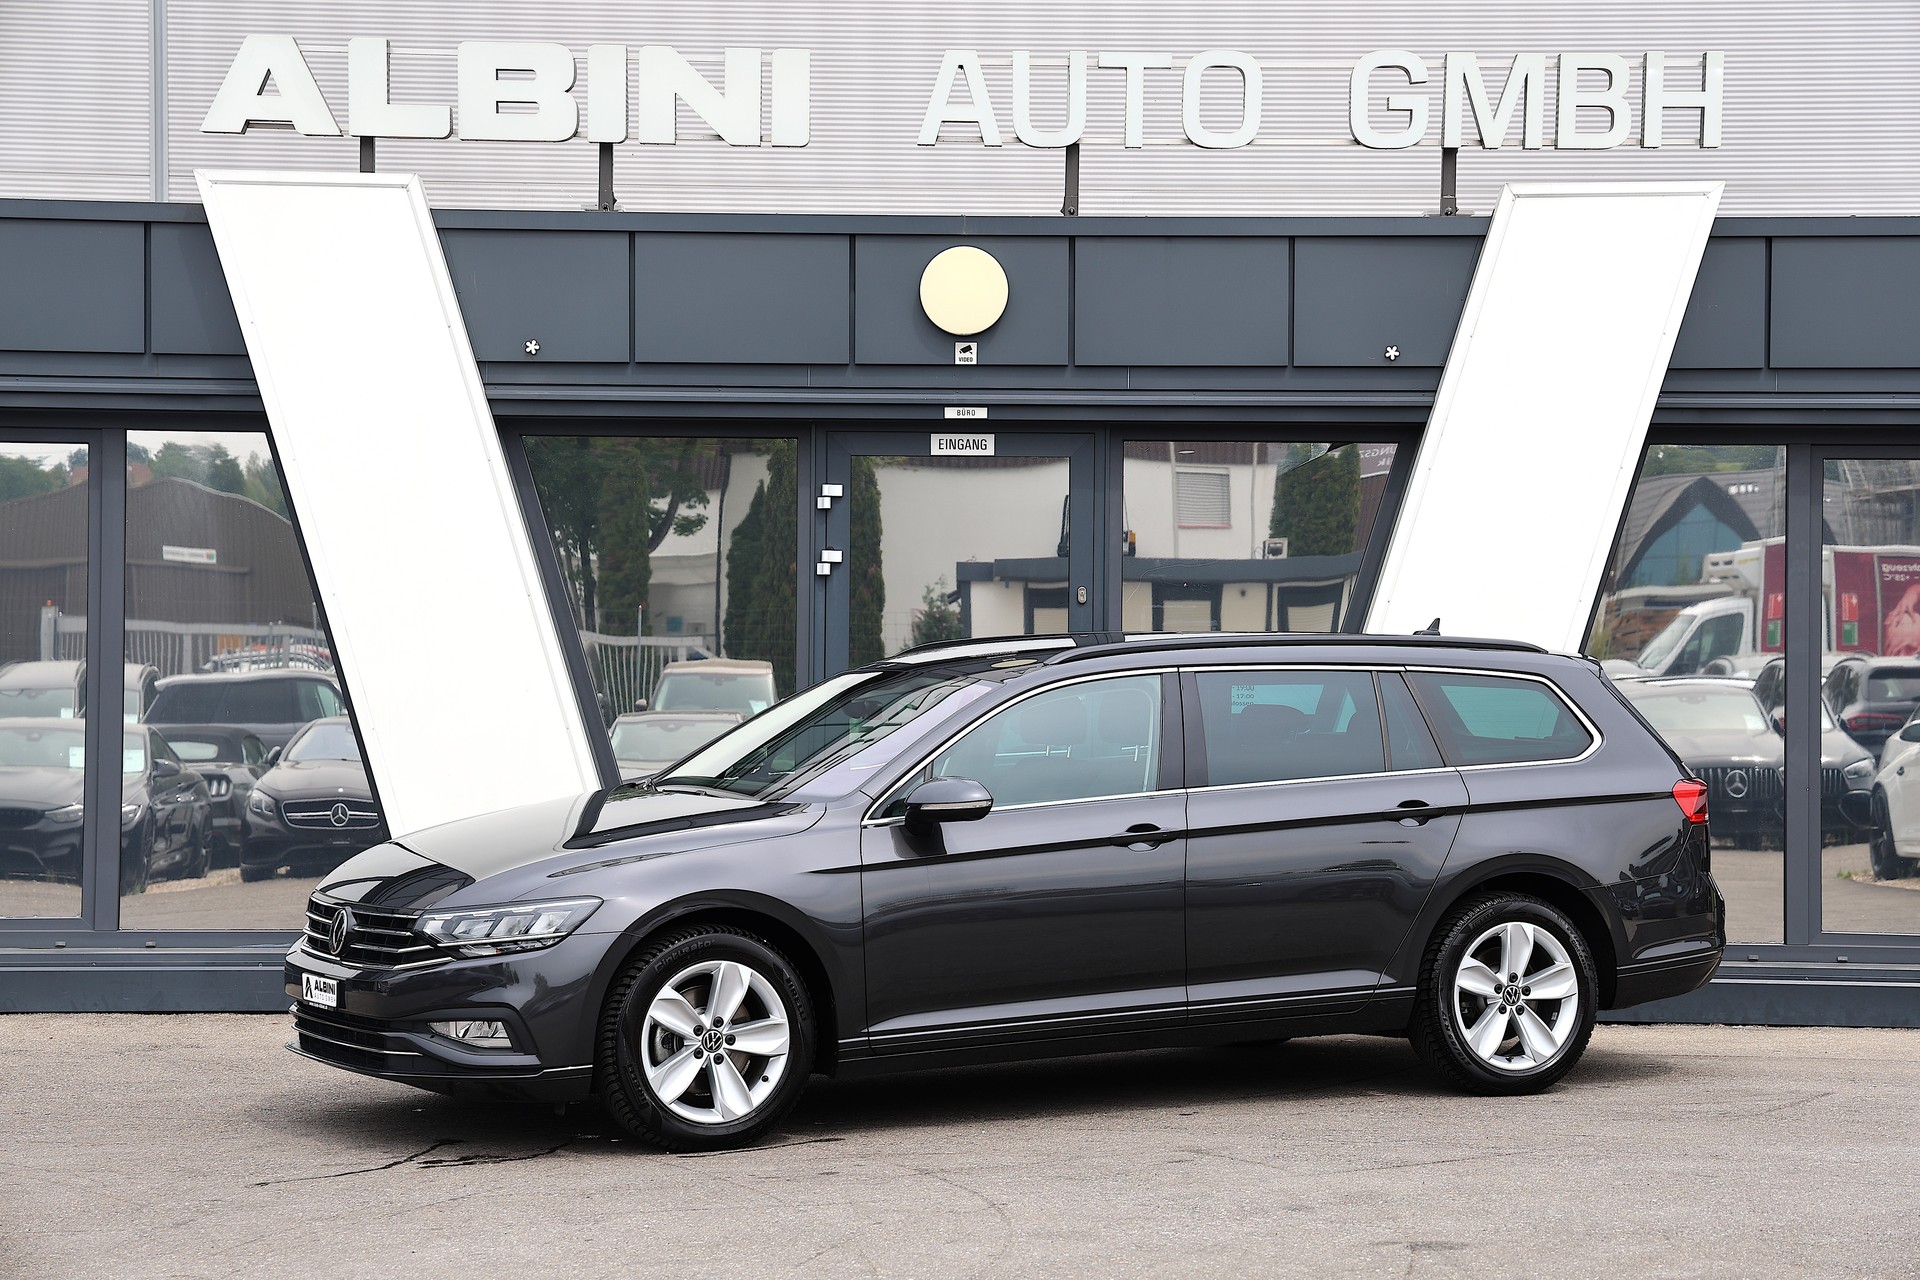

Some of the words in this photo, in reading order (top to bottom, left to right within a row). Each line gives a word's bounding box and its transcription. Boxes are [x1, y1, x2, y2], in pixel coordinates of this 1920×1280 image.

[201, 34, 811, 148] ALBINI
[917, 49, 1263, 149] AUTO
[1349, 49, 1725, 149] GMBH
[956, 408, 976, 417] BÜRO
[938, 438, 988, 451] EINGANG
[314, 979, 336, 996] ALBINI
